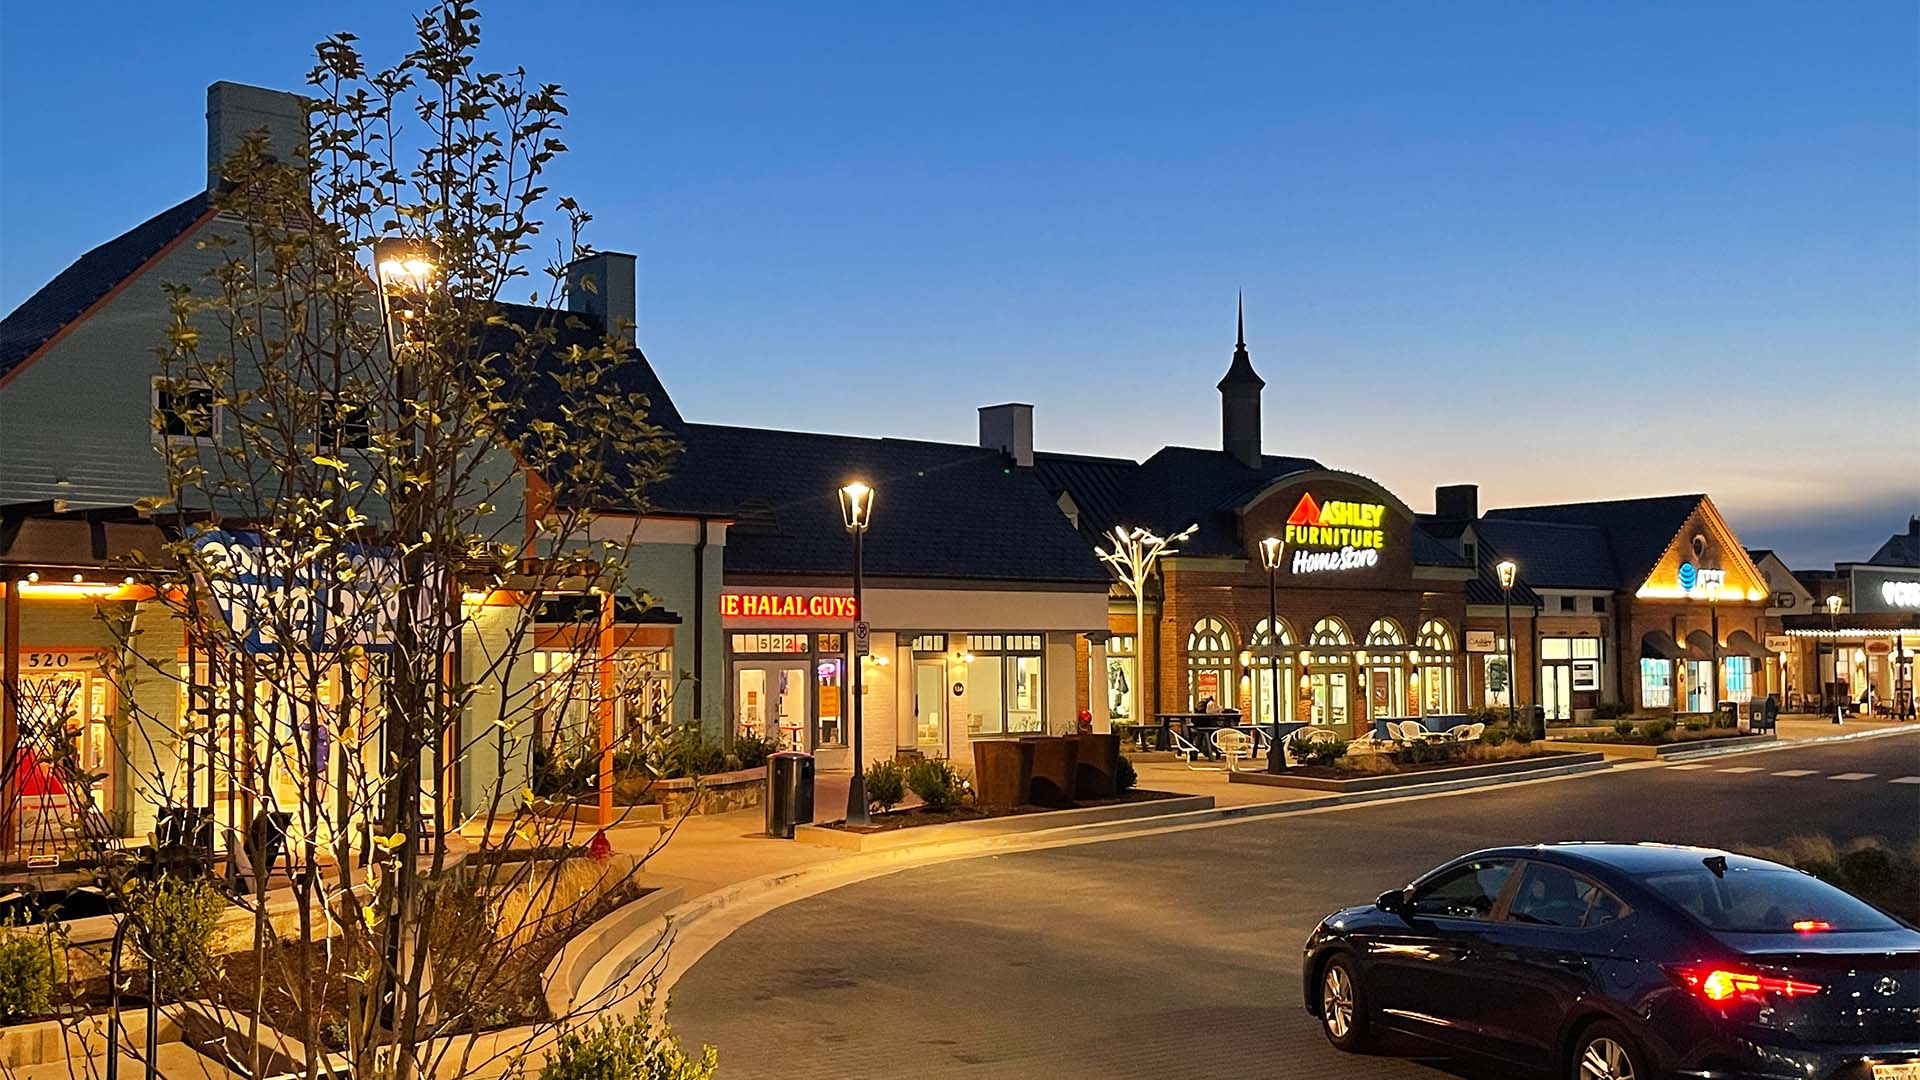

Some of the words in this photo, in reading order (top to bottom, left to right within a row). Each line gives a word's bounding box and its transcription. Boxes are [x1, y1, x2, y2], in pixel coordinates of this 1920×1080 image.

[1319, 500, 1385, 527] ASHLEY
[1285, 525, 1384, 549] FURNITURE
[742, 595, 808, 616] HALAL
[809, 596, 856, 616] GUYS
[759, 638, 794, 649] 522
[28, 653, 69, 667] 520
